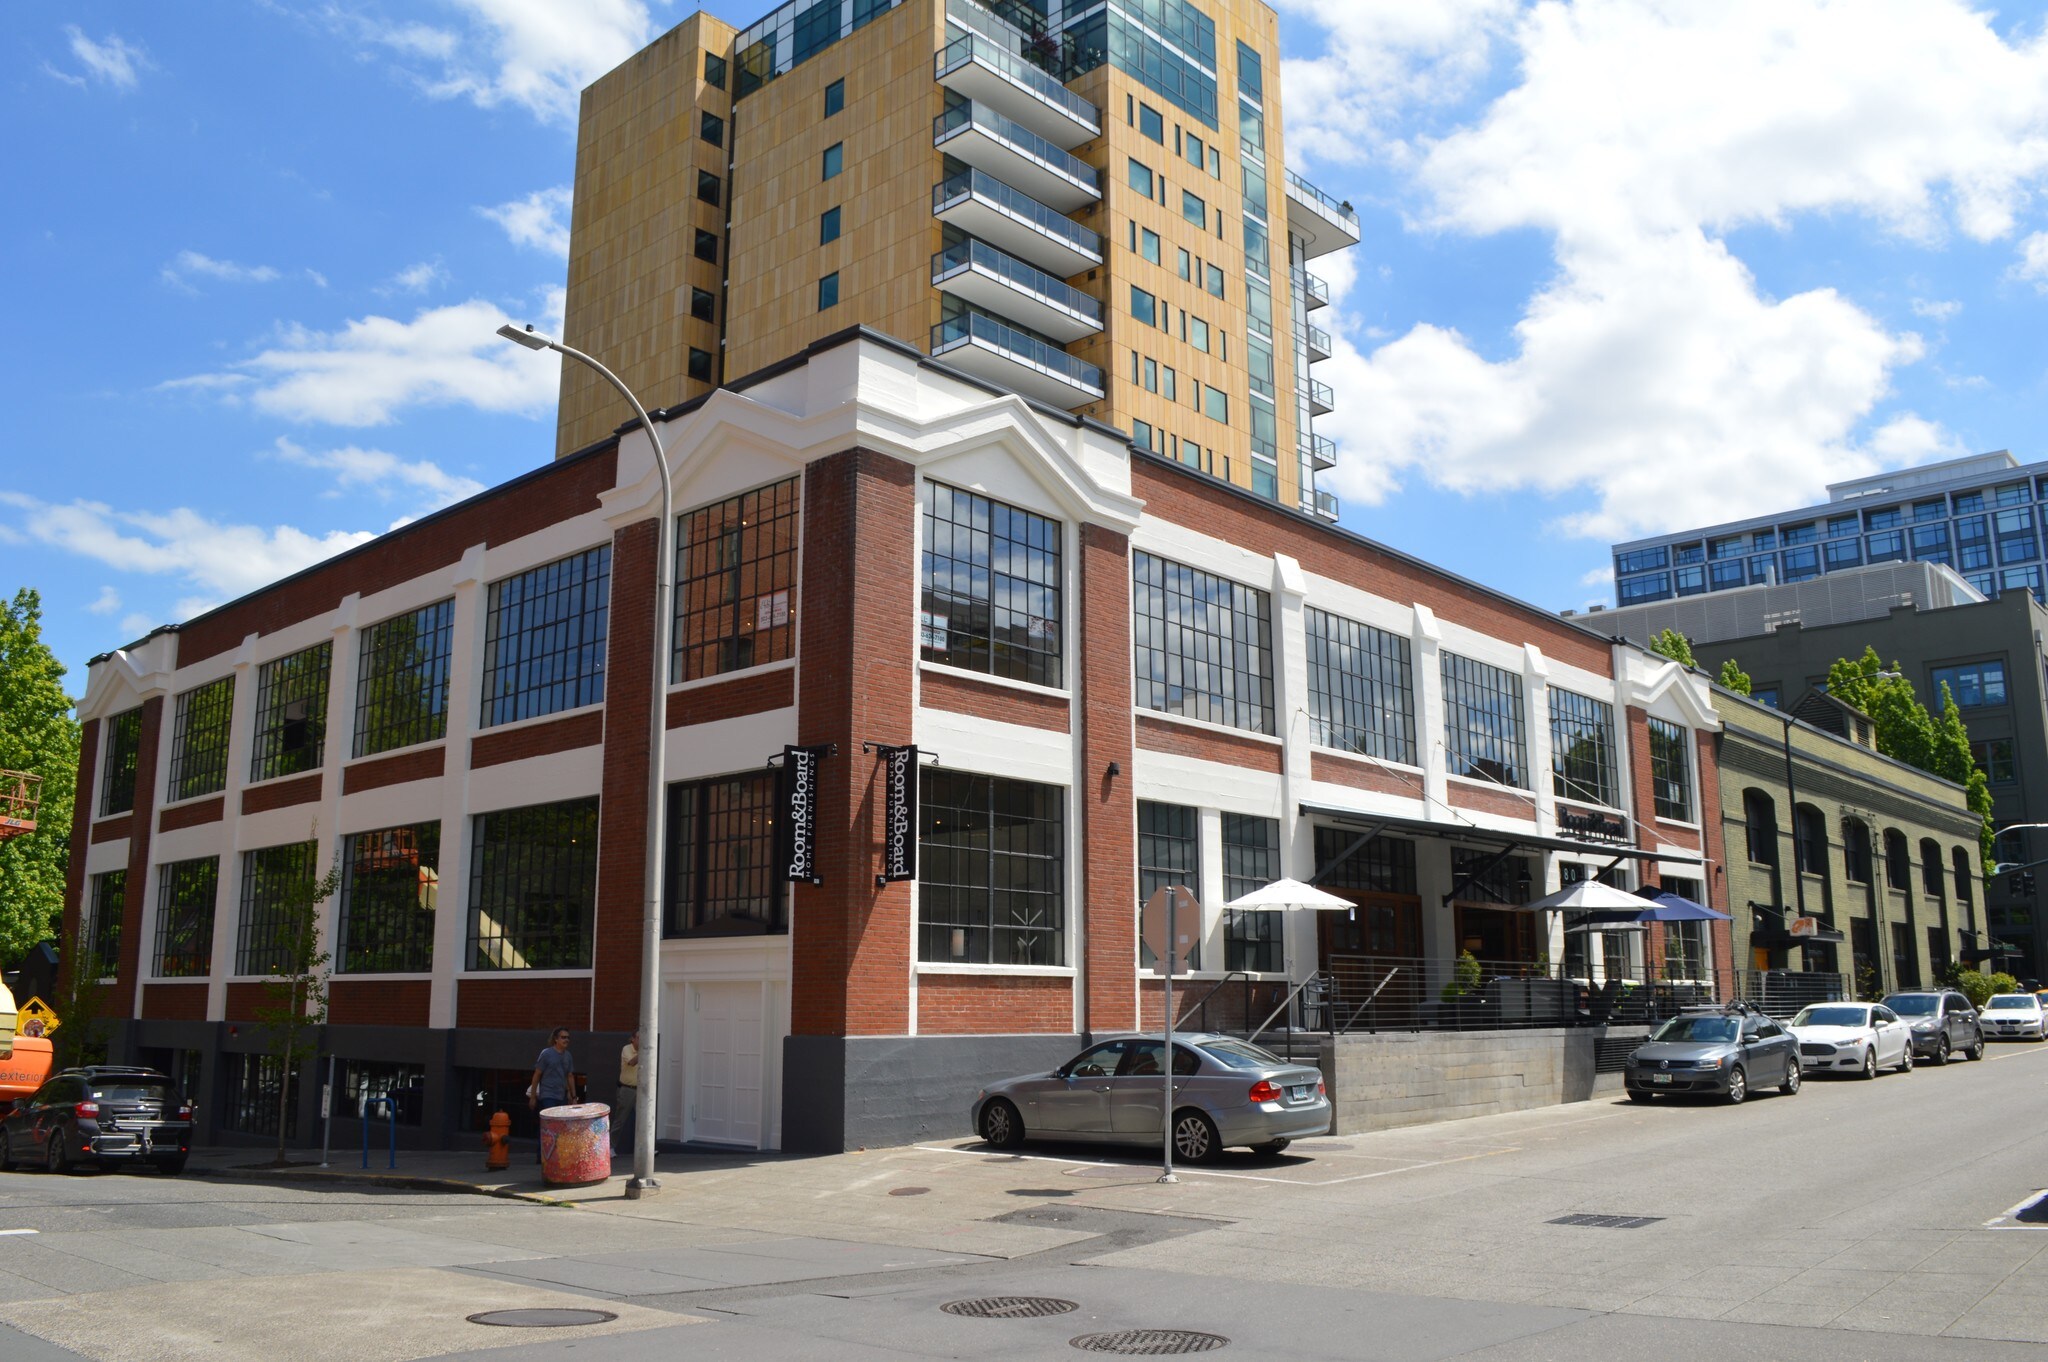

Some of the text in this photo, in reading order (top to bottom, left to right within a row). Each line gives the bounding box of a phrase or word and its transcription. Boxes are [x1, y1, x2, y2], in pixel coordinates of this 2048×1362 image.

[789, 751, 808, 878] Room&Board
[807, 753, 815, 836] FURNISHINGS
[893, 750, 909, 877] Room&Board
